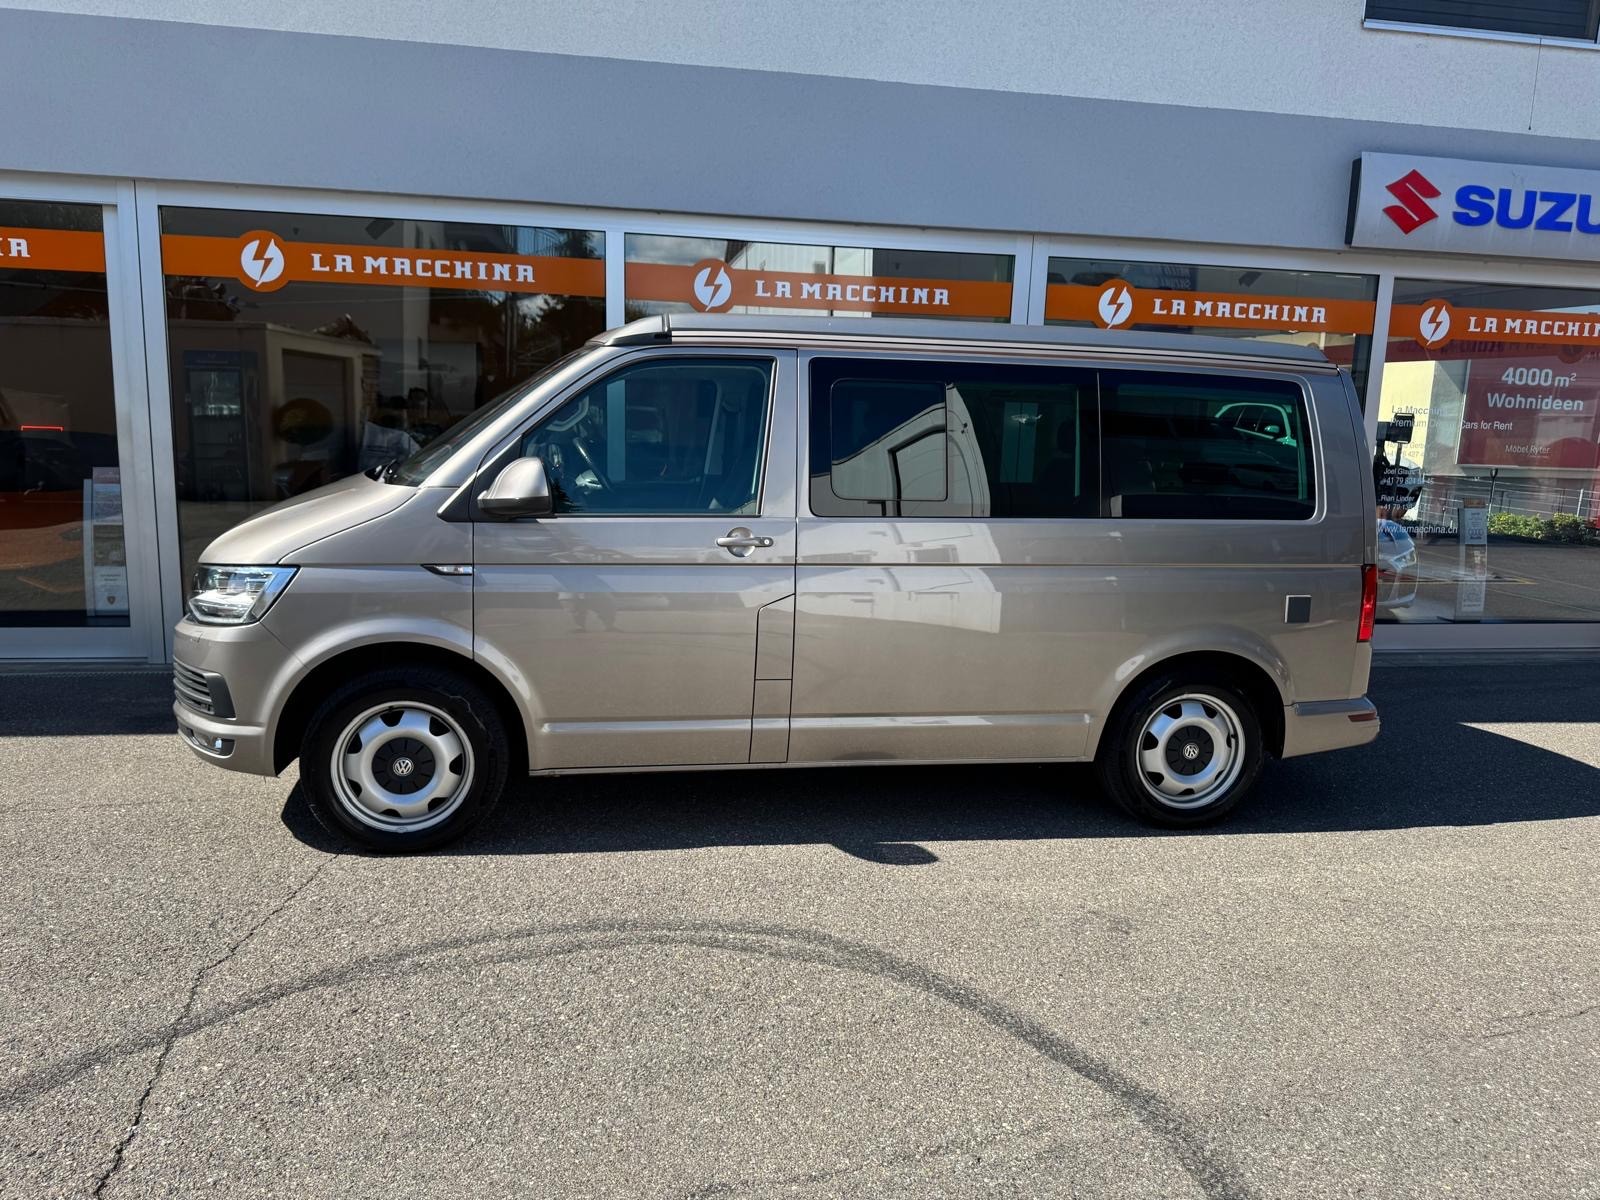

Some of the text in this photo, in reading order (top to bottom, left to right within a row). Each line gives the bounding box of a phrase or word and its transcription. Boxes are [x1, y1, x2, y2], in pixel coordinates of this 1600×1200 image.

[311, 252, 536, 284] LA MACCHINA
[755, 279, 951, 307] LA MACCHINA
[1152, 298, 1327, 325] LA MACCHINA
[1468, 316, 1498, 333] LA
[1501, 366, 1553, 387] 4000
[1487, 392, 1584, 411] Wohnideen
[1461, 420, 1478, 430] Cars
[1480, 420, 1491, 430] for
[1493, 421, 1513, 431] Rent
[1395, 477, 1404, 485] 79
